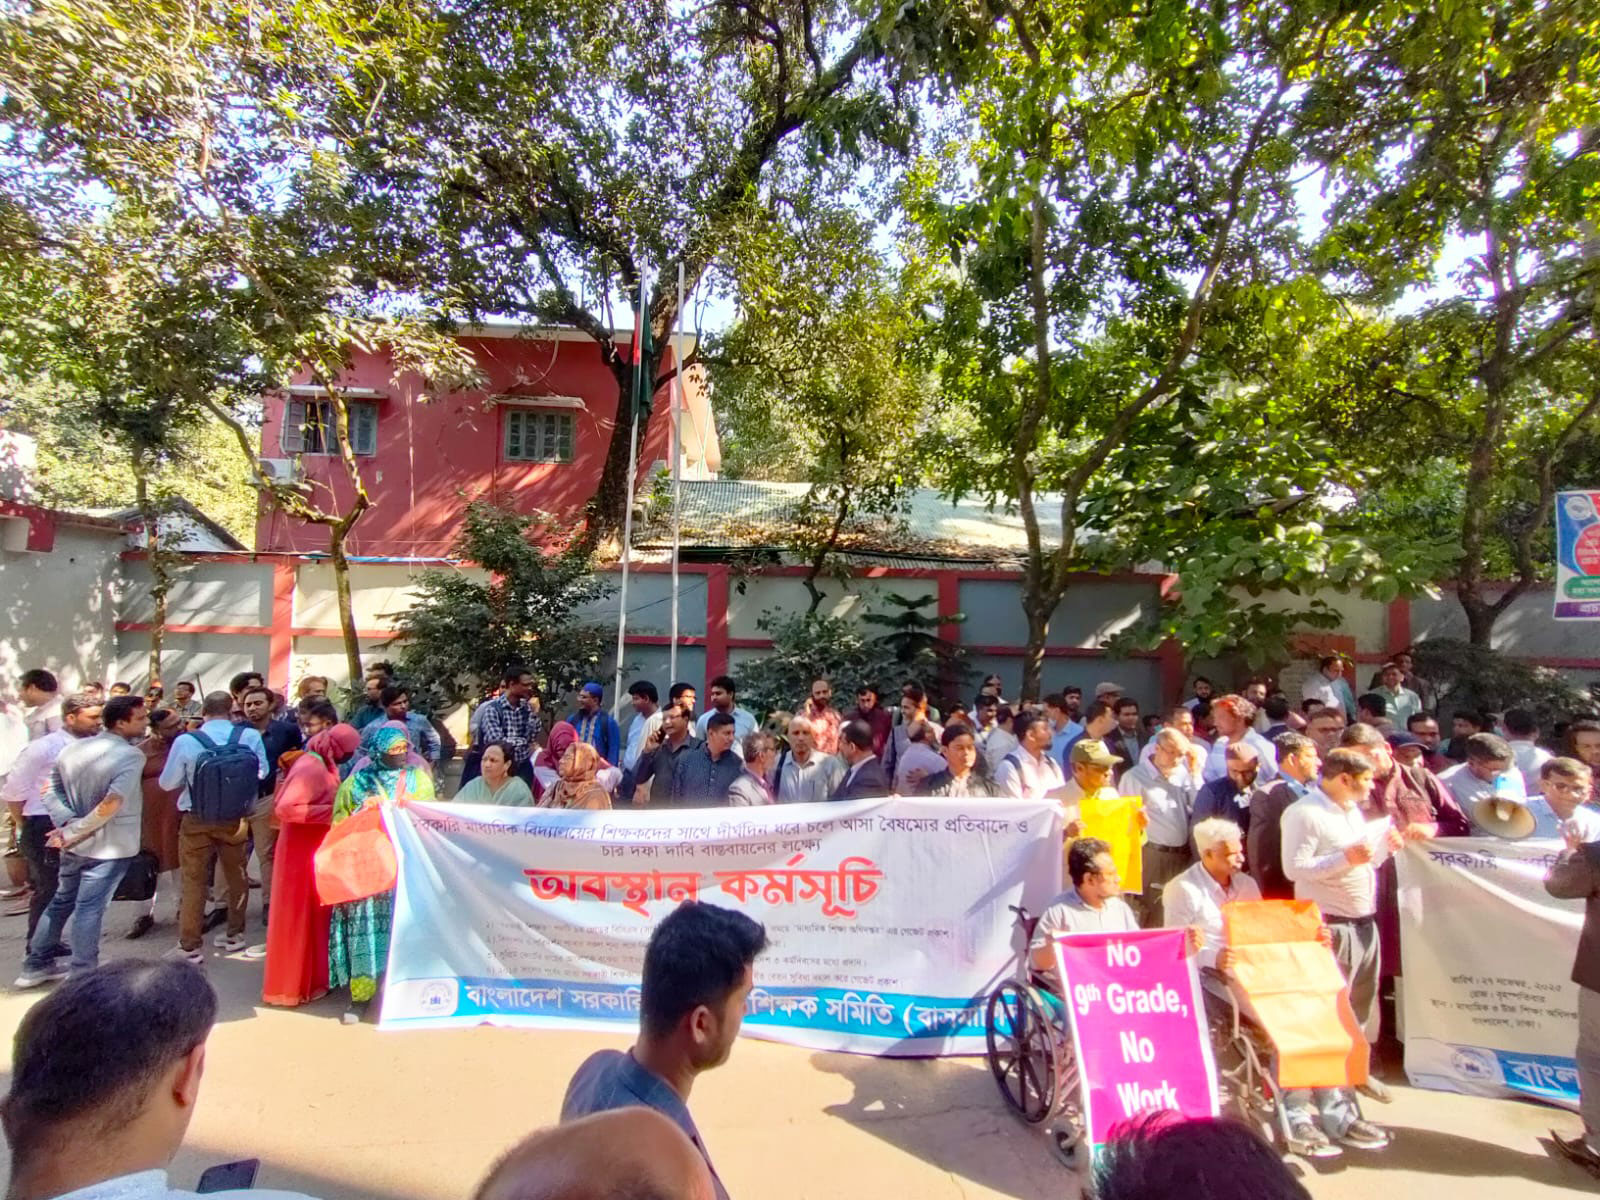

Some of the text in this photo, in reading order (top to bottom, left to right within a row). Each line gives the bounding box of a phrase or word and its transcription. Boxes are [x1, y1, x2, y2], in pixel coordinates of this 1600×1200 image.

[465, 819, 520, 836] মাধ্যমিক
[524, 821, 594, 840] বিদ্যালয়ের
[601, 823, 671, 841] শিক্ষকদের
[677, 823, 711, 840] সাথে
[717, 820, 768, 839] দীর্ঘদিন
[774, 821, 800, 836] ধরে
[807, 820, 833, 833] চলে
[841, 817, 873, 832] আসা
[879, 815, 938, 832] বৈষম্যের
[944, 814, 1009, 834] প্রতিবাদে
[1016, 820, 1028, 833] ও
[600, 838, 821, 858] চার দফা দাবি বাস্তবায়নের লক্ষ্যে
[523, 853, 885, 919] অবস্থান কর্মসূচি
[1106, 940, 1141, 968] No
[464, 985, 564, 1009] বাংলাদেশ
[570, 986, 641, 1011] সরকারি
[749, 987, 820, 1019] শিক্ষক
[825, 991, 895, 1026] সমিতি
[1074, 983, 1188, 1018] 9th Grade,
[1119, 1031, 1155, 1064] No
[1116, 1080, 1180, 1118] Work
